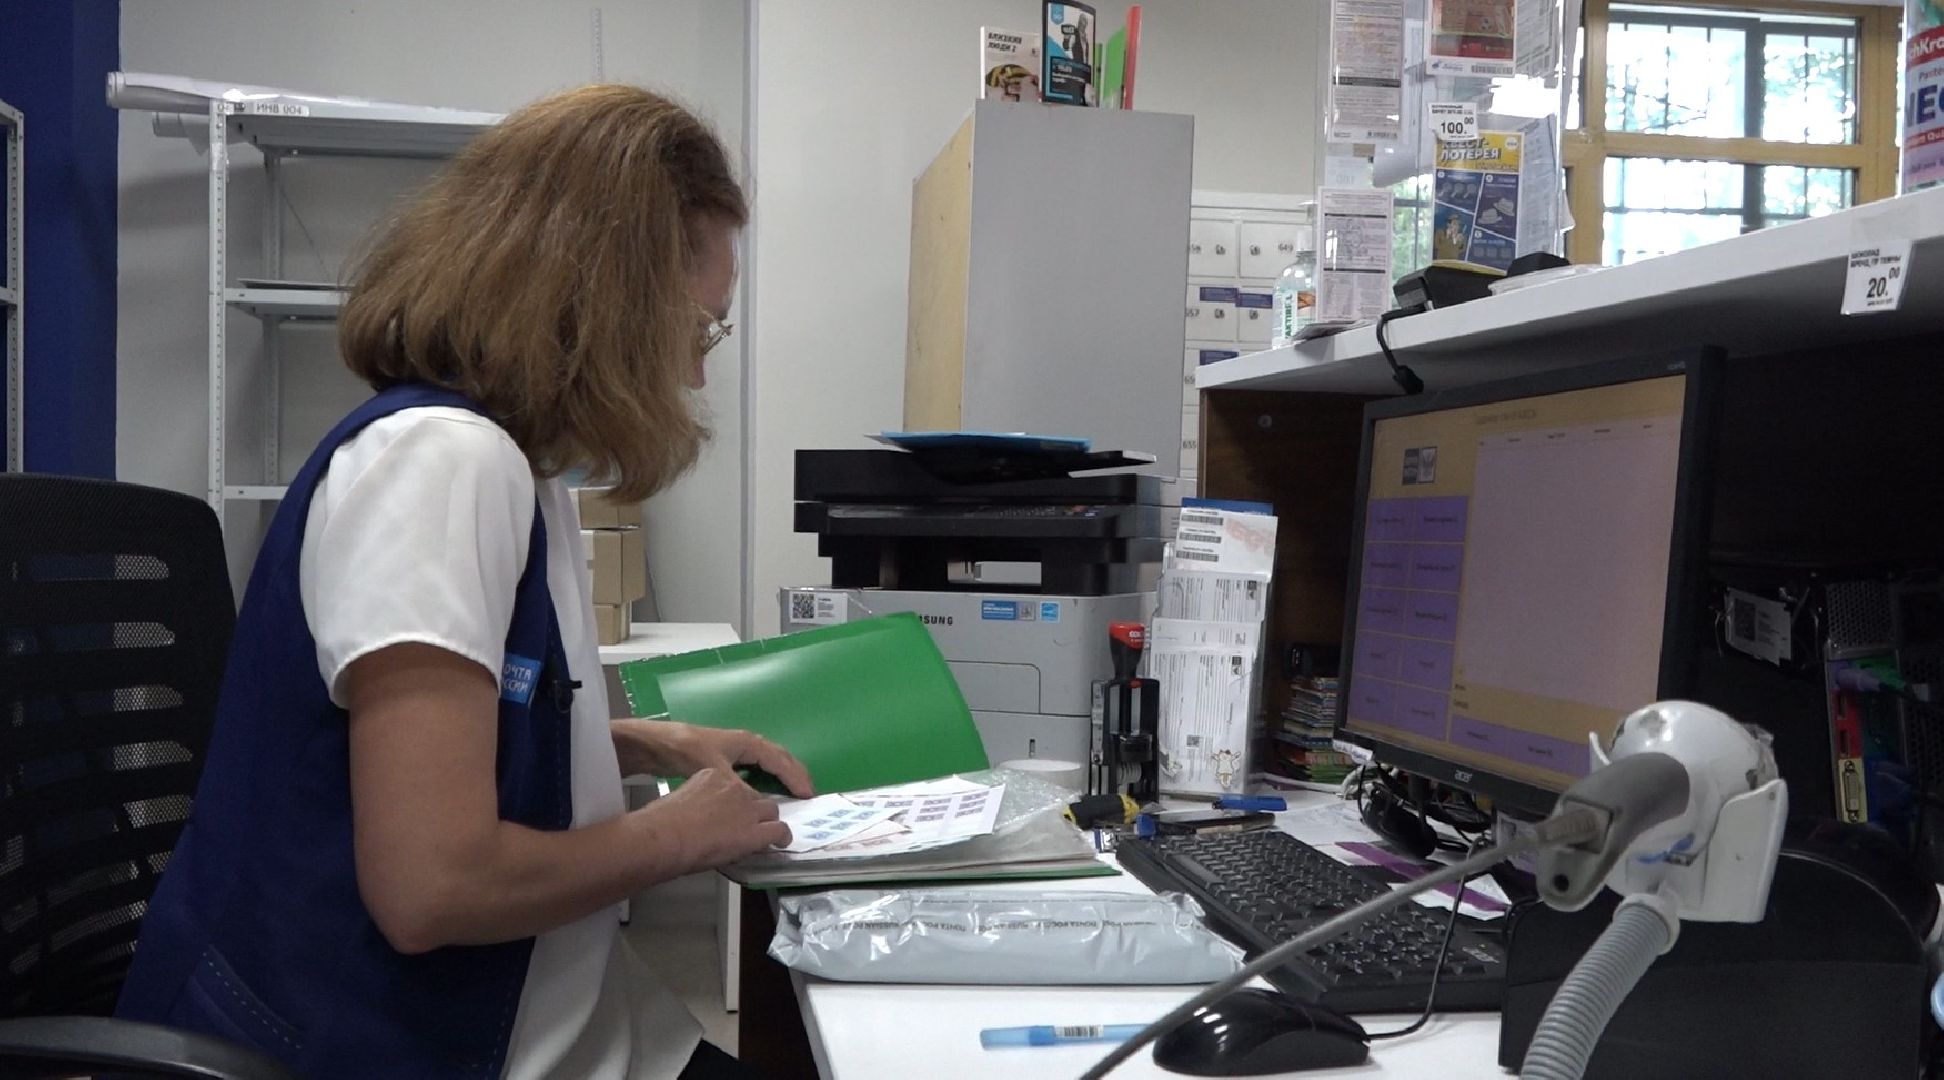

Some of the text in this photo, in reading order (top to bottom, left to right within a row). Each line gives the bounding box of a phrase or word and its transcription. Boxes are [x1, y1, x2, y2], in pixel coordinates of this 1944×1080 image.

[1464, 117, 1475, 125] 00
[1441, 148, 1501, 162] ЛОТЕРЕЯ
[1889, 266, 1901, 280] 00
[1187, 308, 1200, 317] 57
[504, 663, 532, 681] ОЧТА
[503, 678, 529, 694] ССИИ
[1455, 769, 1473, 783] acer
